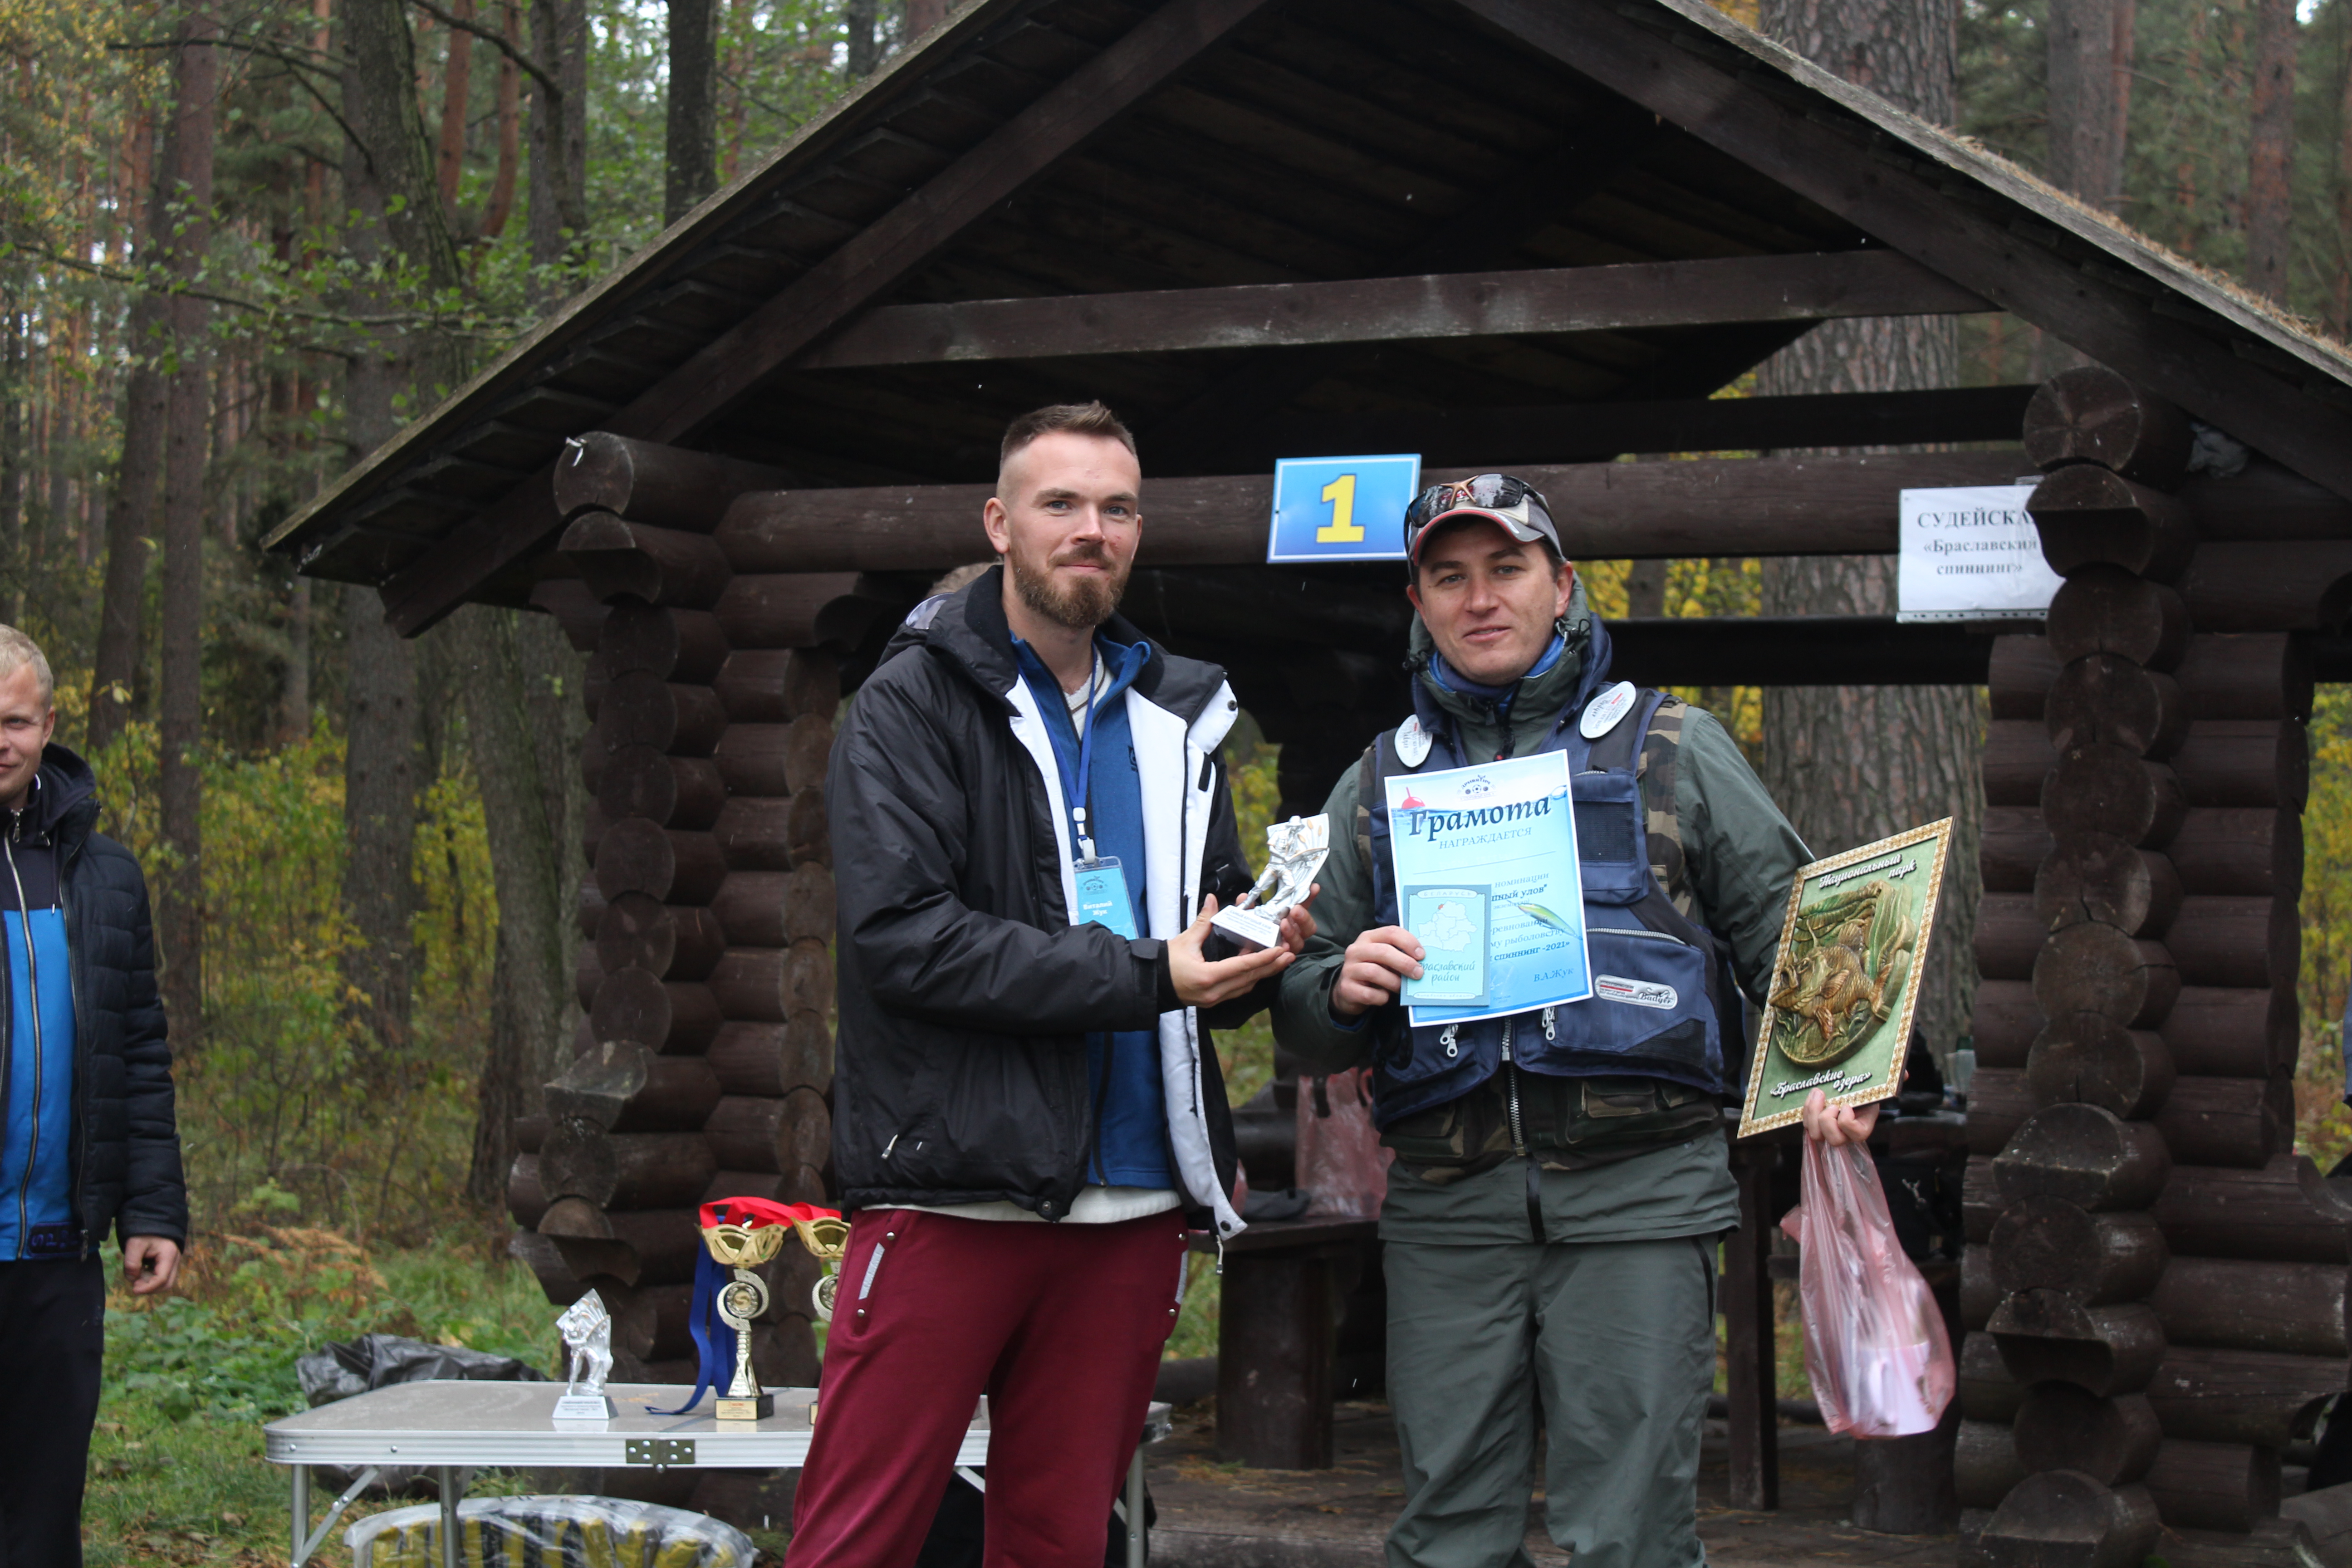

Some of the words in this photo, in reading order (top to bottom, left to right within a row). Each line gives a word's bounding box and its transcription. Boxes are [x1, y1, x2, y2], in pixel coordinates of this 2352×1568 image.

[1316, 474, 1365, 543] 1
[1917, 507, 2034, 529] СУДЕЙСКА
[1923, 536, 2037, 555] «Браславский
[1936, 564, 2023, 575] спиннинг»
[1408, 796, 1551, 842] Грамота
[1439, 827, 1532, 849] НАГРАЖДАЕТСЯ
[1819, 853, 1902, 888] Национальный
[1888, 858, 1917, 879] парк
[1494, 872, 1549, 888] номинации
[1520, 884, 1548, 899] улов"
[1083, 900, 1113, 910] Виталий
[1494, 946, 1541, 961] спиннинг
[1420, 960, 1476, 971] раславский
[1431, 971, 1460, 986] район
[1638, 991, 1672, 1004] Badger
[1770, 1069, 1845, 1098] «Браславские
[1833, 1071, 1872, 1093] озера»
